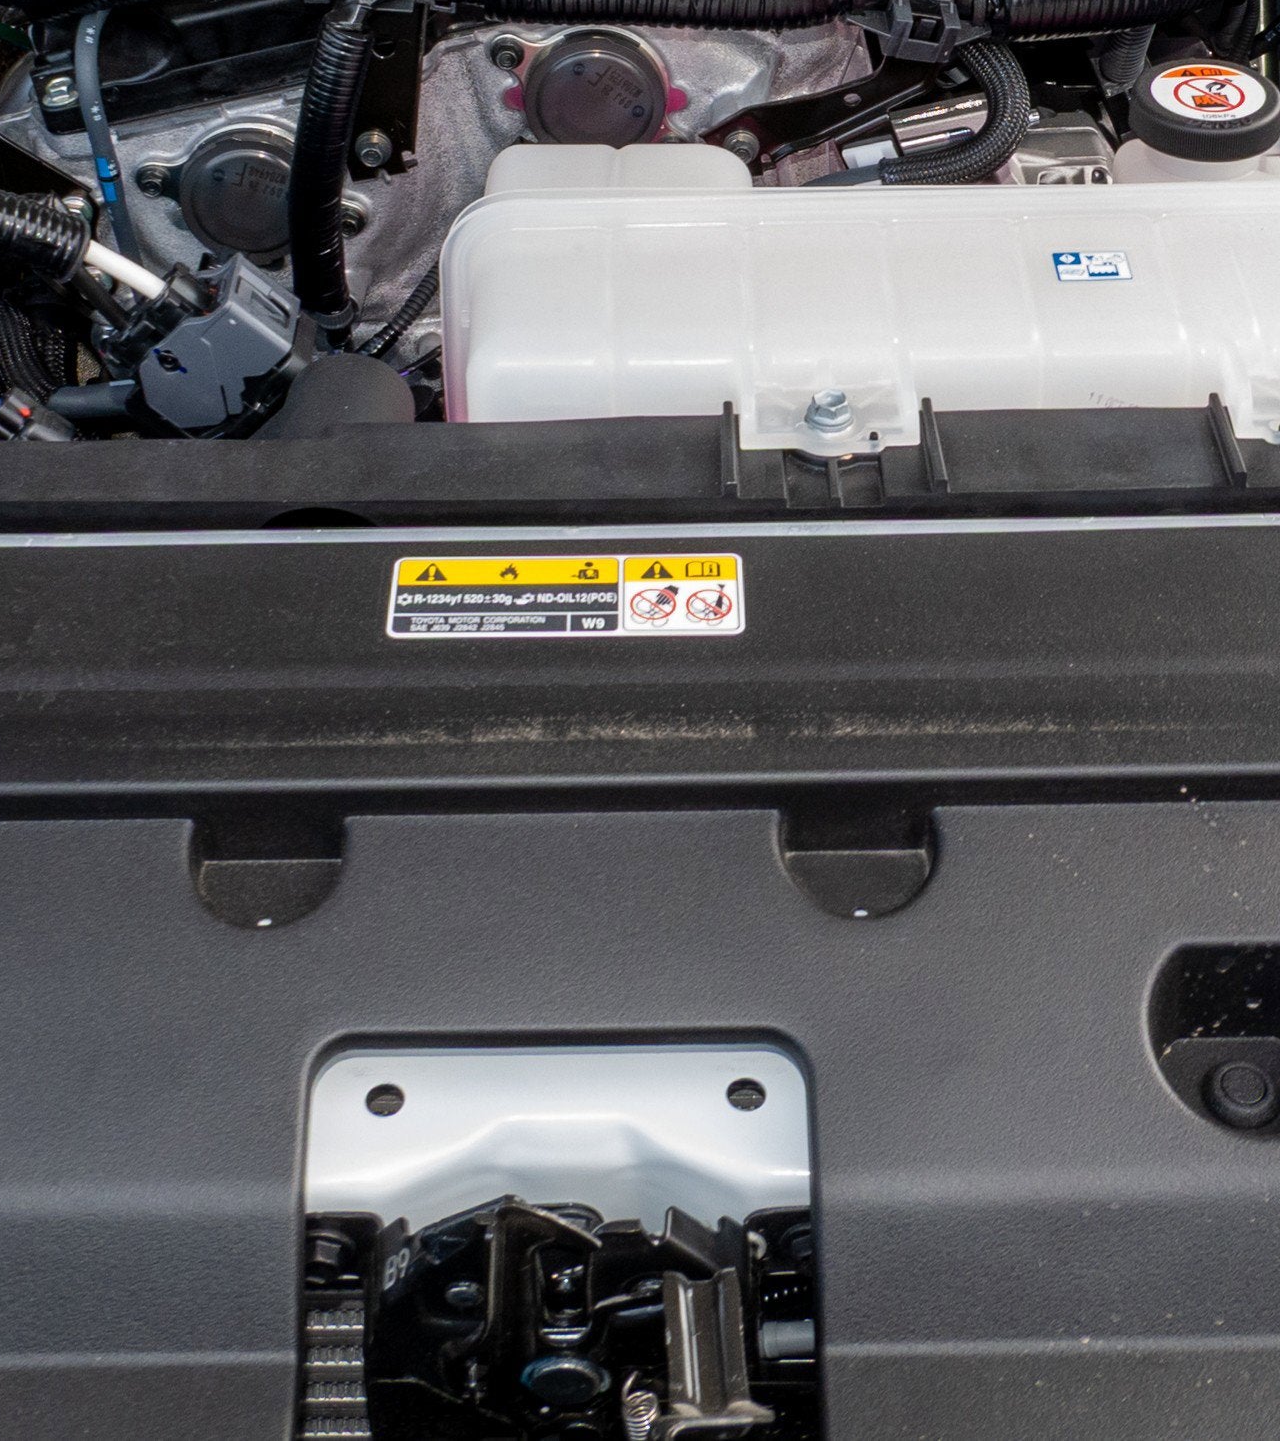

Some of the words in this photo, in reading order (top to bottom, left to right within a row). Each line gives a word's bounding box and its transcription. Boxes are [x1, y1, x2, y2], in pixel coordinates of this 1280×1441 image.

[413, 594, 462, 606] R-1234yf
[463, 593, 513, 606] 520±30g
[537, 592, 618, 605] ND-OIL12(POE)
[410, 617, 445, 625] TOYOTA
[483, 616, 546, 624] CORPORATION
[581, 617, 605, 629] W9
[383, 1247, 411, 1291] B9
